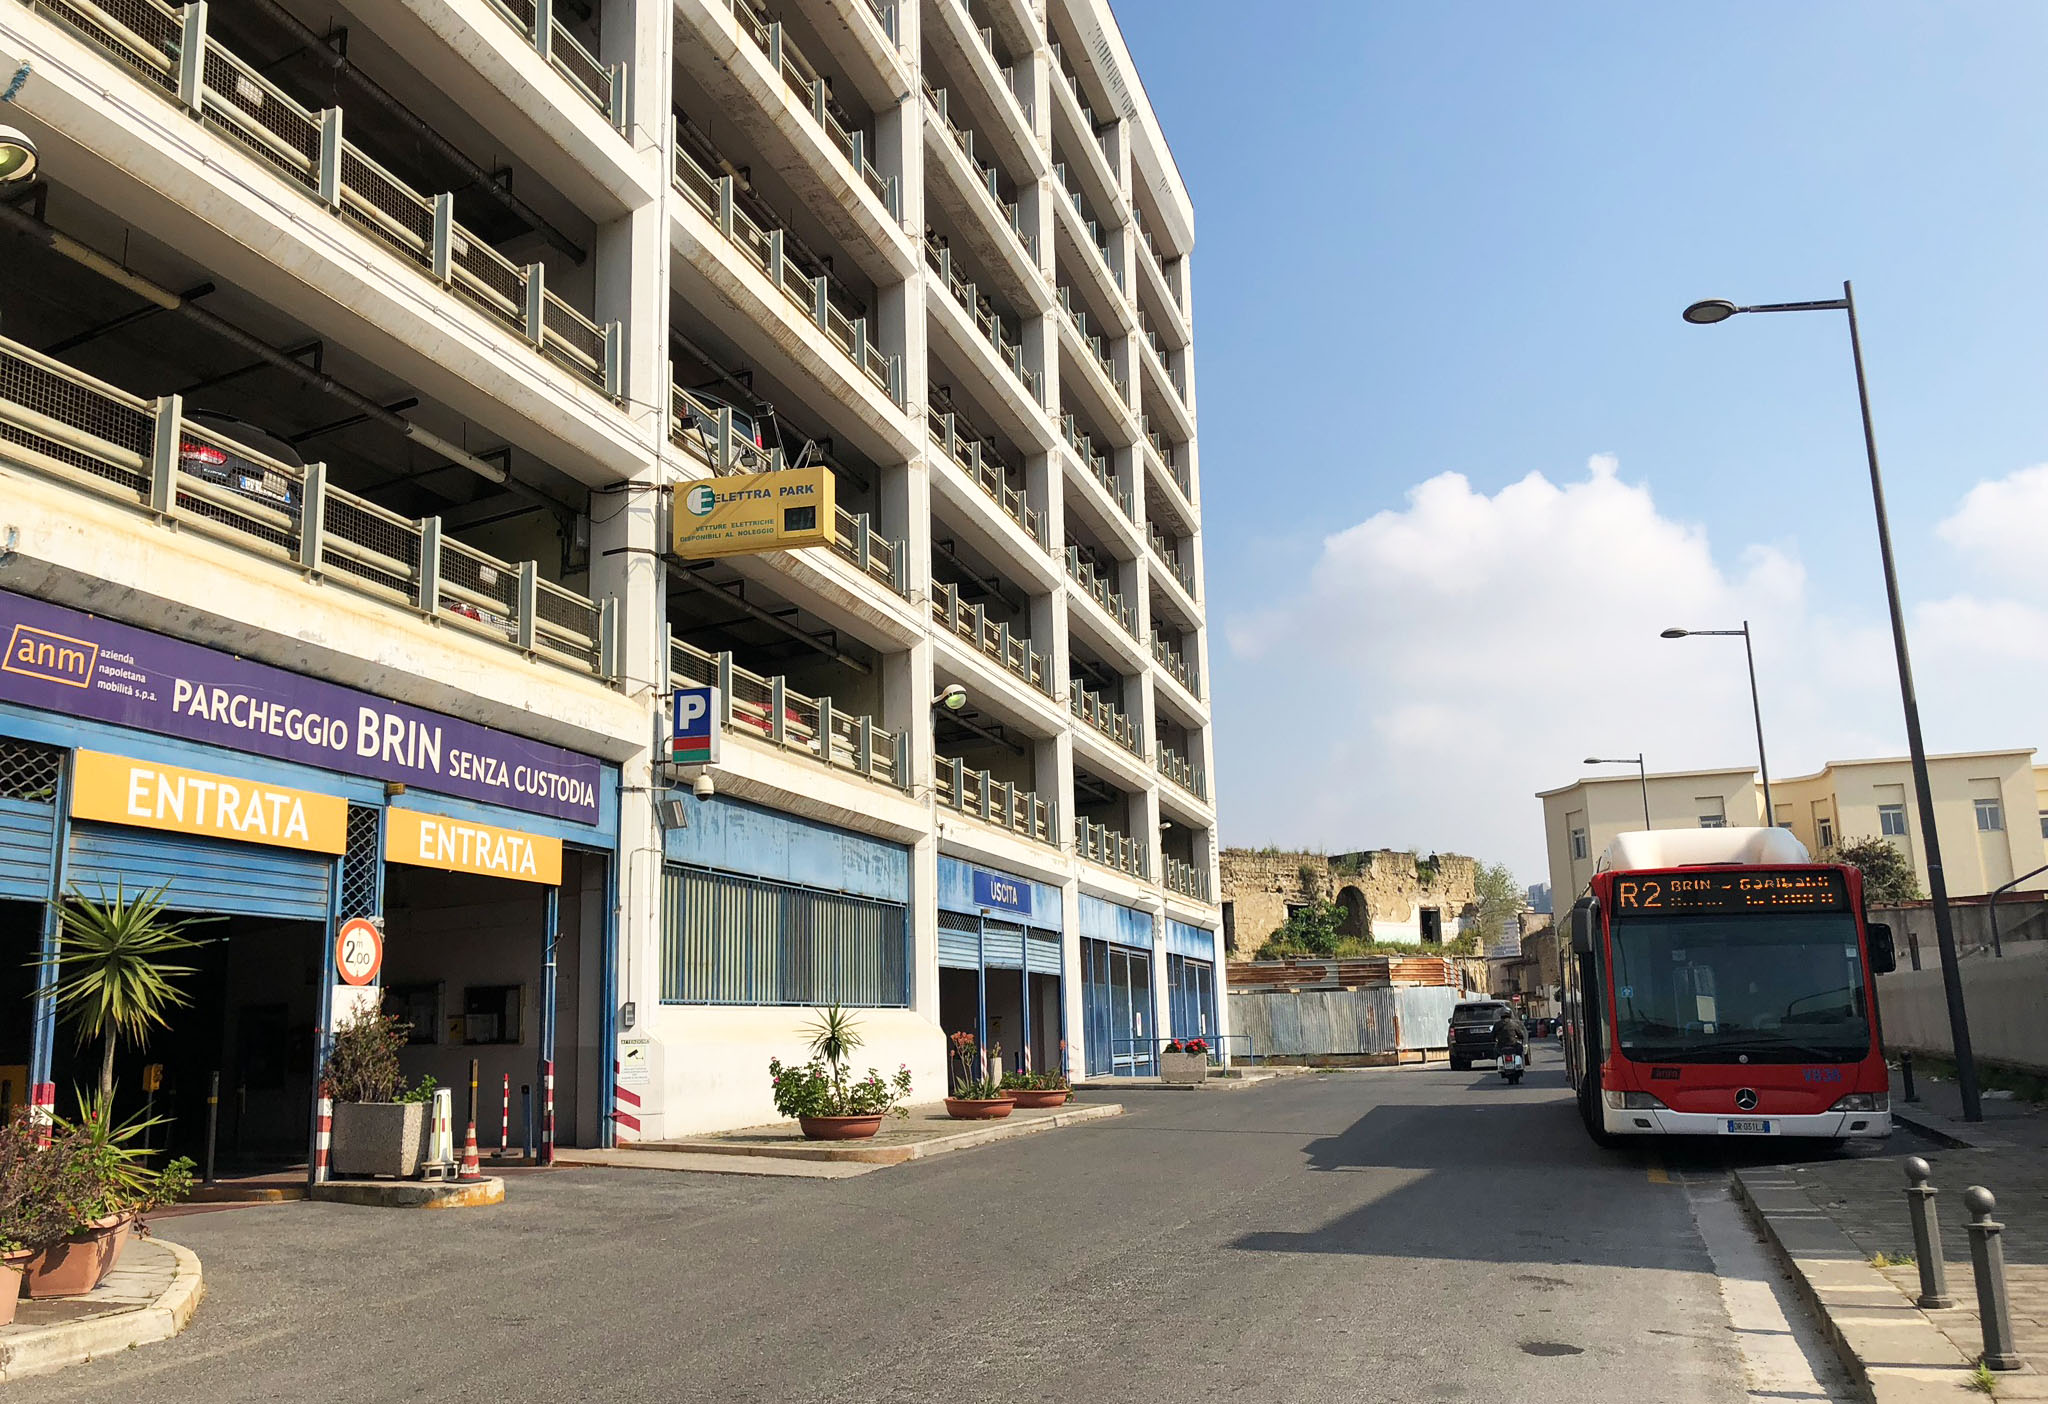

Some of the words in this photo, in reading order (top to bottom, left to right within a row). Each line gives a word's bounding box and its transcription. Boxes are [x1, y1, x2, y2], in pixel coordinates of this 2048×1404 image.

[779, 484, 815, 497] PARK
[680, 532, 721, 542] DISPONIBILI
[738, 527, 774, 536] NOLEGGIO
[695, 523, 727, 532] VETTURE
[731, 519, 774, 528] ELETTRICHE
[17, 638, 85, 675] anm
[100, 648, 134, 665] azienda
[98, 665, 146, 684] napoletana
[97, 680, 133, 696] mobilità
[135, 689, 158, 701] s.p.a.
[679, 694, 707, 730] P
[172, 678, 349, 751] PARCHEGGIO
[357, 706, 442, 773] BRIN
[449, 749, 510, 788] SENZA
[514, 765, 595, 808] CUSTODIA
[128, 768, 309, 842] ENTRATA
[418, 821, 537, 876] ENTRATA
[990, 880, 1018, 905] USCITA
[1620, 882, 1662, 908] R2
[1670, 879, 1711, 892] BRIN
